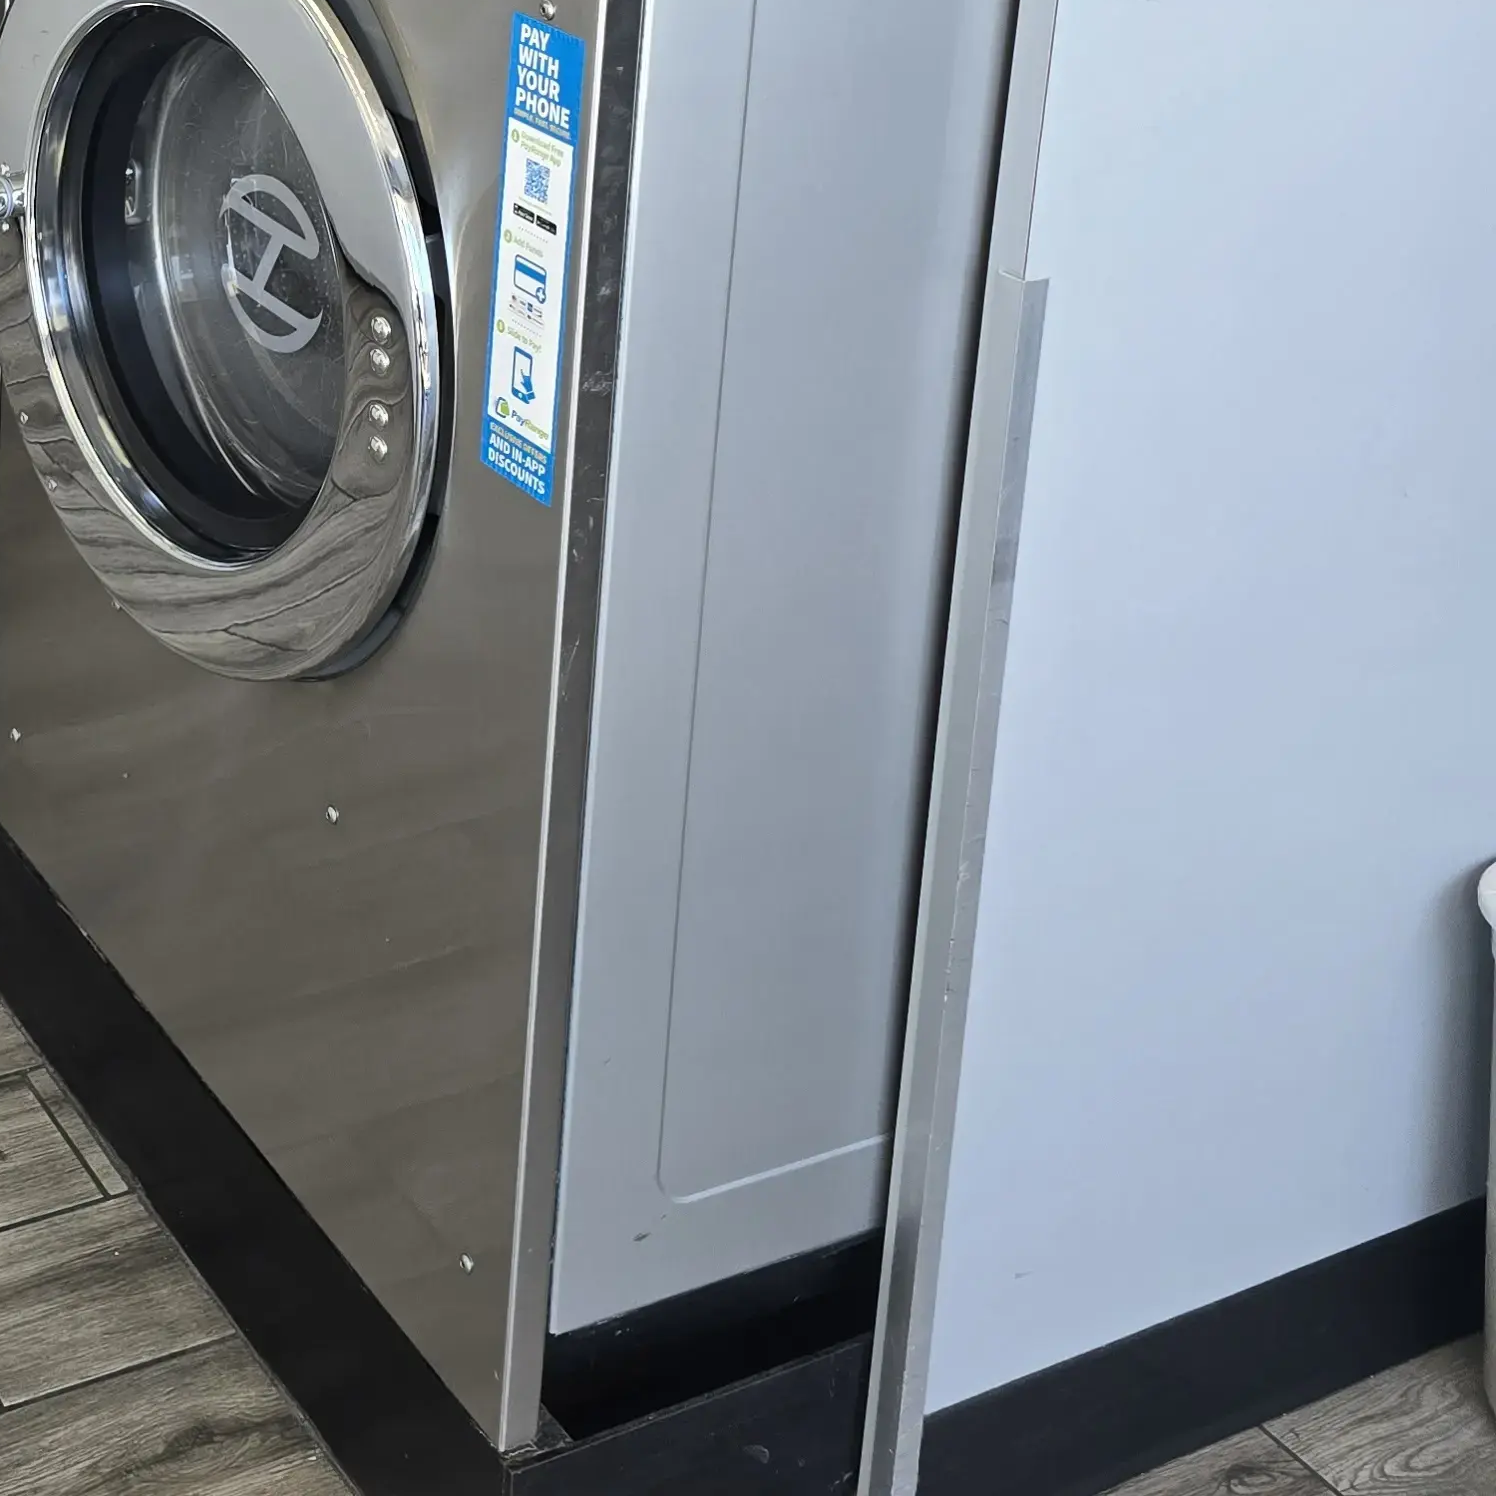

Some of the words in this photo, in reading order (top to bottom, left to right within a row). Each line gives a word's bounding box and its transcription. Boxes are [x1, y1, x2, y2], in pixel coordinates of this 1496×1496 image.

[520, 23, 550, 52] PAY
[519, 44, 559, 80] WITH
[517, 65, 560, 103] YOUR
[515, 87, 570, 130] PHONE
[488, 447, 545, 495] DISCOUNTS
[489, 433, 510, 452] AND
[511, 448, 546, 477] IN-APP
